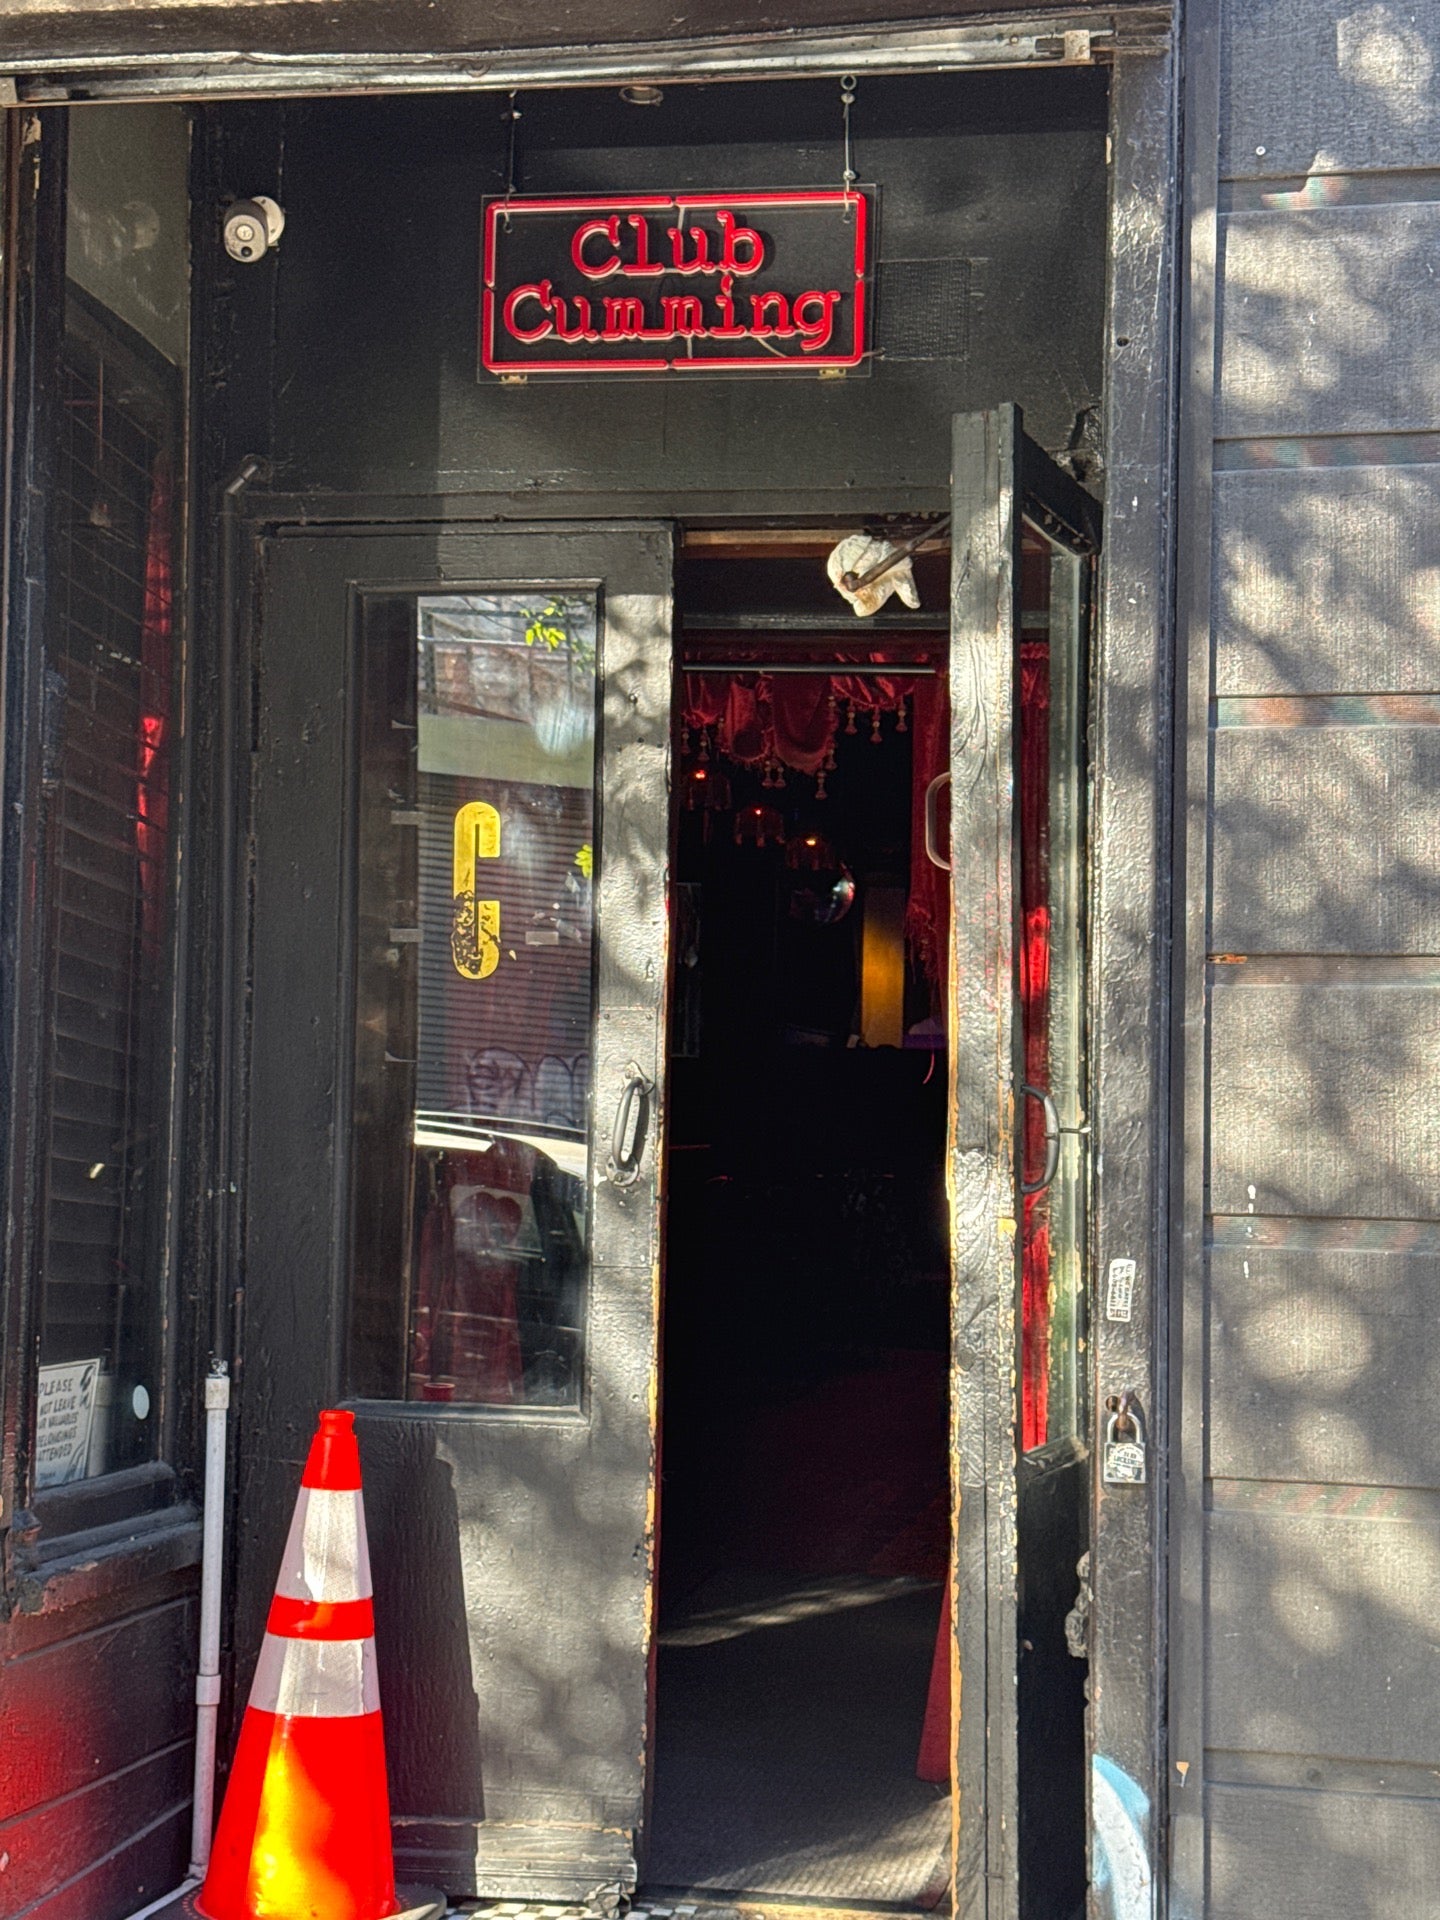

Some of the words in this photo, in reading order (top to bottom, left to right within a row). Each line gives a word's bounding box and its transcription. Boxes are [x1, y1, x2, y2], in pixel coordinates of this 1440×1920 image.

[571, 210, 765, 279] Club
[503, 274, 841, 351] Cumming
[39, 1378, 74, 1396] PLEASE
